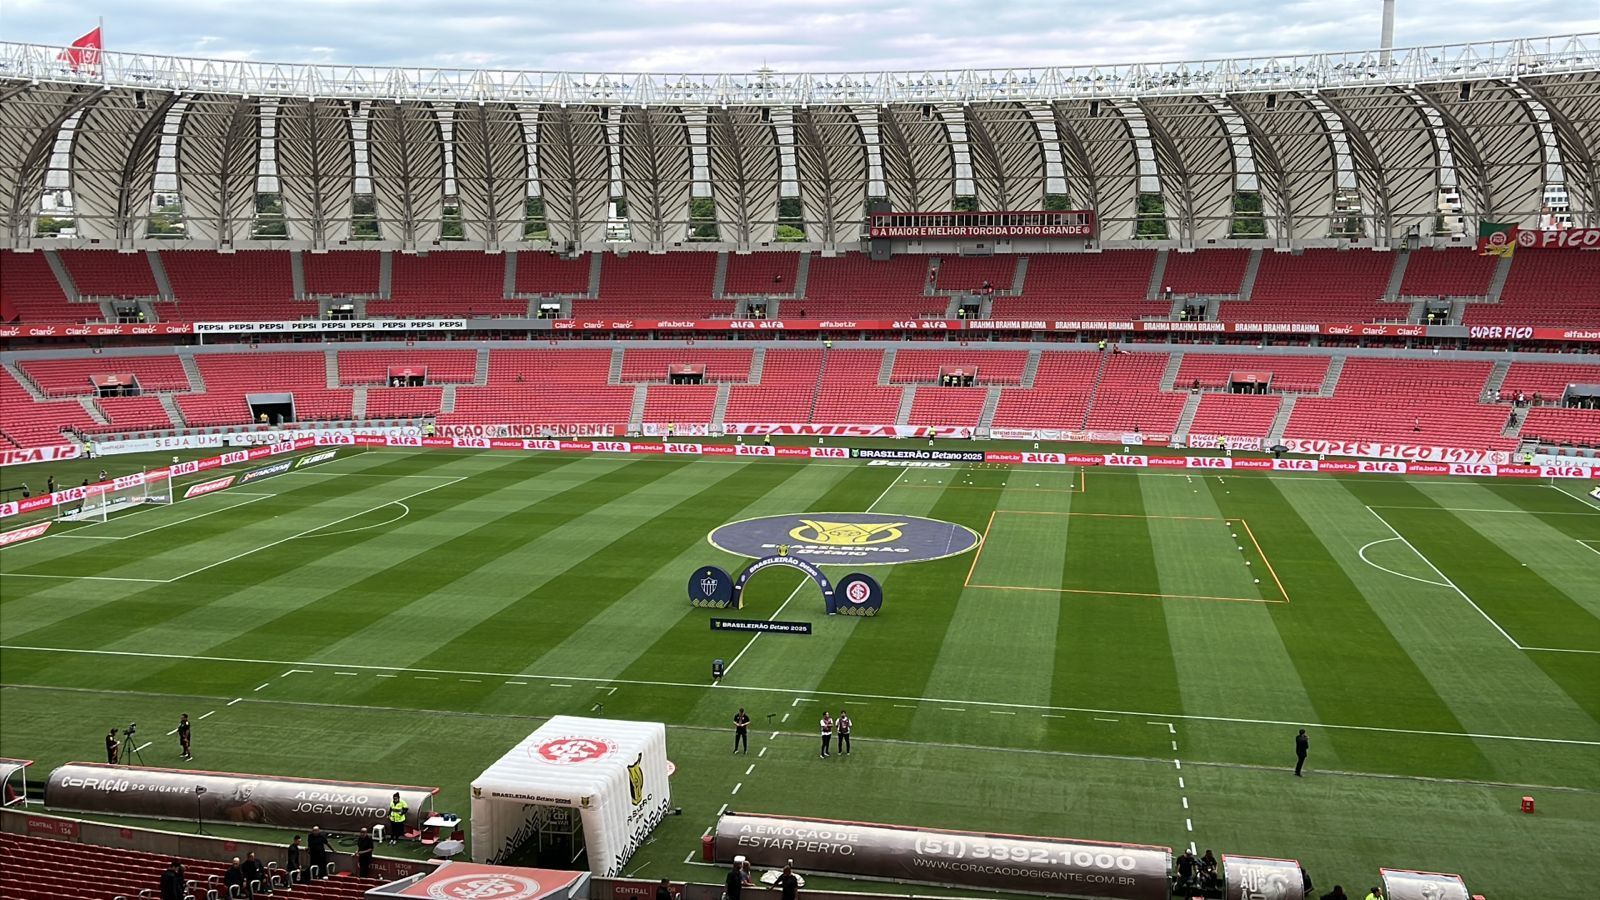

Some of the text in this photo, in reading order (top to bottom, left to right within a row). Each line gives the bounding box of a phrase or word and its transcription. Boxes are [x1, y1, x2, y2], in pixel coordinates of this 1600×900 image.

[890, 228, 919, 236] MAIOR
[920, 228, 926, 236] E
[928, 227, 966, 236] MELHOR
[1042, 226, 1082, 234] GRANDE
[166, 325, 189, 334] Claro
[970, 321, 994, 329] BRAHMA
[995, 321, 1020, 329] BRAHMA
[1055, 321, 1134, 330] BRAHMA BRAHMA BRAHMA
[1171, 322, 1197, 330] BRAHMA
[1198, 323, 1225, 331] BRAHMA
[1235, 323, 1320, 332] BRAHMA BRAHMA BRAHMA
[0, 327, 19, 336] laro
[30, 326, 54, 336] Claro
[66, 326, 90, 335] Claro
[98, 326, 122, 335] Claro
[132, 326, 155, 334] Claro
[1328, 326, 1352, 334] Claro
[1362, 327, 1386, 335] Claro
[1397, 328, 1420, 336] Claro
[1470, 327, 1502, 338] SUPER
[155, 438, 189, 447] SEJA
[198, 436, 217, 445] UM
[319, 436, 349, 444] alfa
[390, 436, 418, 445] alfa
[457, 438, 485, 446] alfa
[528, 440, 555, 448] alfa
[273, 442, 292, 453] alfa
[597, 442, 625, 450] alfa
[670, 444, 698, 452] alfa
[740, 446, 769, 454] alfa
[1300, 440, 1372, 455] SUPER
[814, 449, 844, 457] alfa
[860, 450, 930, 459] BRASILEIRÃO
[931, 451, 960, 460] Betano
[224, 452, 245, 464] alfa
[1027, 454, 1060, 463] alfa
[1110, 456, 1143, 465] alfa
[1192, 458, 1226, 467] alfa
[174, 463, 195, 474] alfa
[1278, 460, 1313, 469] alfa
[1364, 462, 1400, 472] alfa
[1455, 464, 1492, 474] alfa
[1546, 467, 1584, 476] alfa
[56, 488, 83, 502] alfa
[749, 557, 798, 574] BRASILEIRÃO
[722, 621, 769, 630] BRASILEIRÃO
[61, 776, 129, 794] CORAÇÃO
[148, 784, 190, 794] GIGANTE
[295, 791, 306, 800] A
[292, 802, 333, 814] JOGA
[29, 820, 53, 830] CENTRAL
[835, 832, 859, 842] DE
[738, 836, 856, 856] ESTAR PERTO.
[914, 838, 1136, 871] (51) 3392.1000
[913, 858, 1136, 886] WWW.CORACAODOGIGANTE.COM.BR
